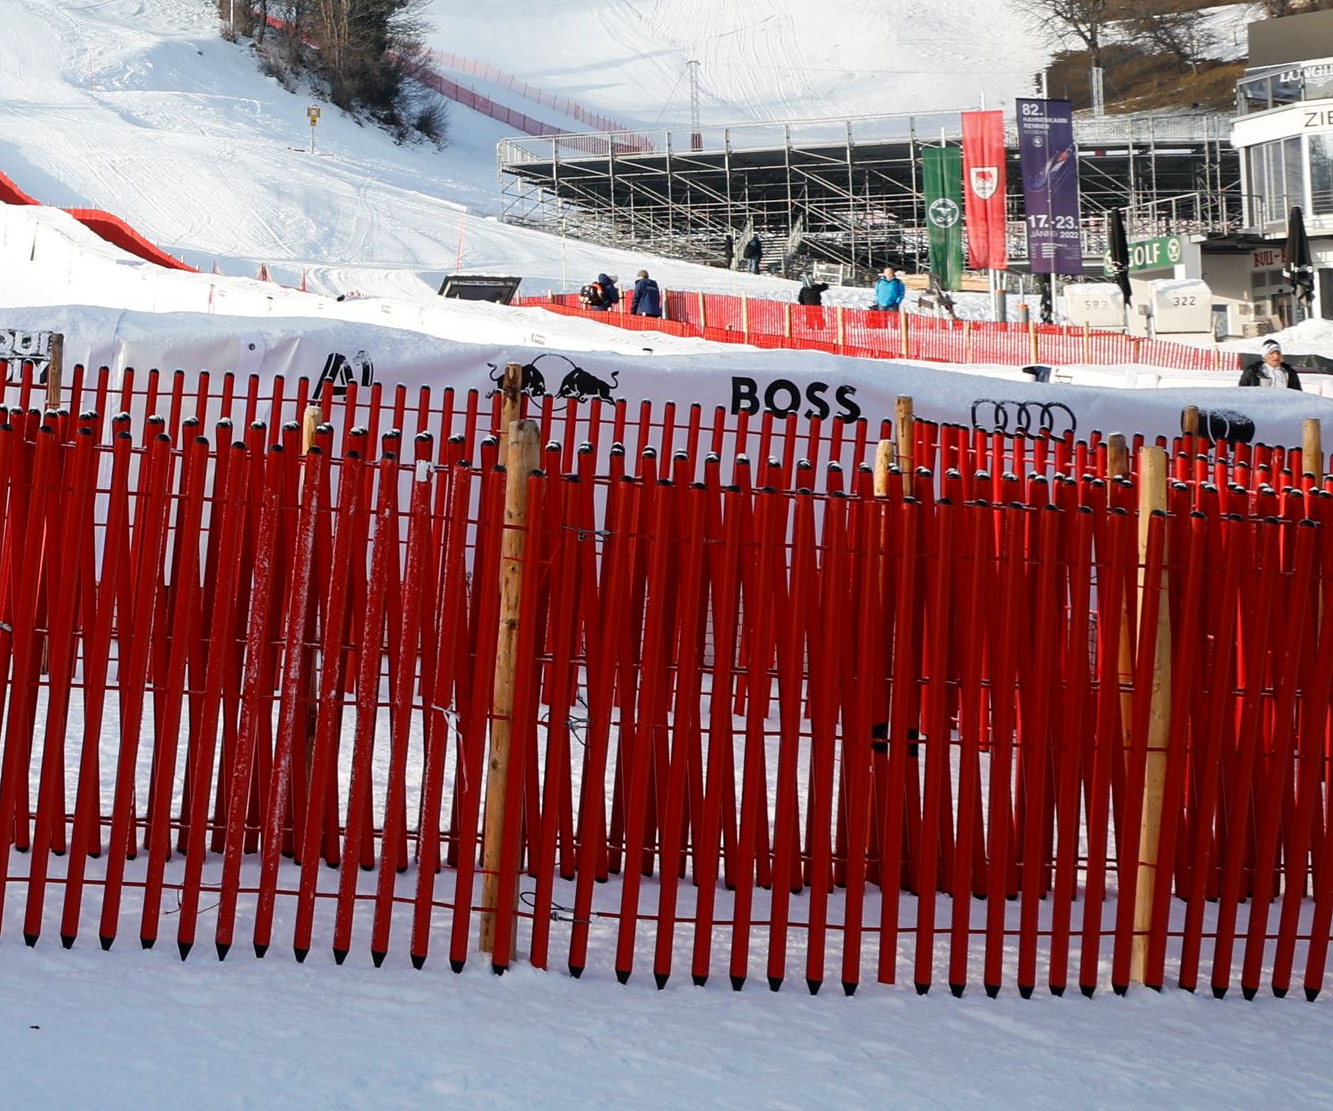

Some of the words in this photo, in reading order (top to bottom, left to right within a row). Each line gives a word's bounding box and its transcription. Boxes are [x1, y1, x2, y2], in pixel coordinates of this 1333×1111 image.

[1022, 103, 1044, 116] 82.
[1172, 296, 1196, 306] 322
[730, 376, 861, 424] BOSS
